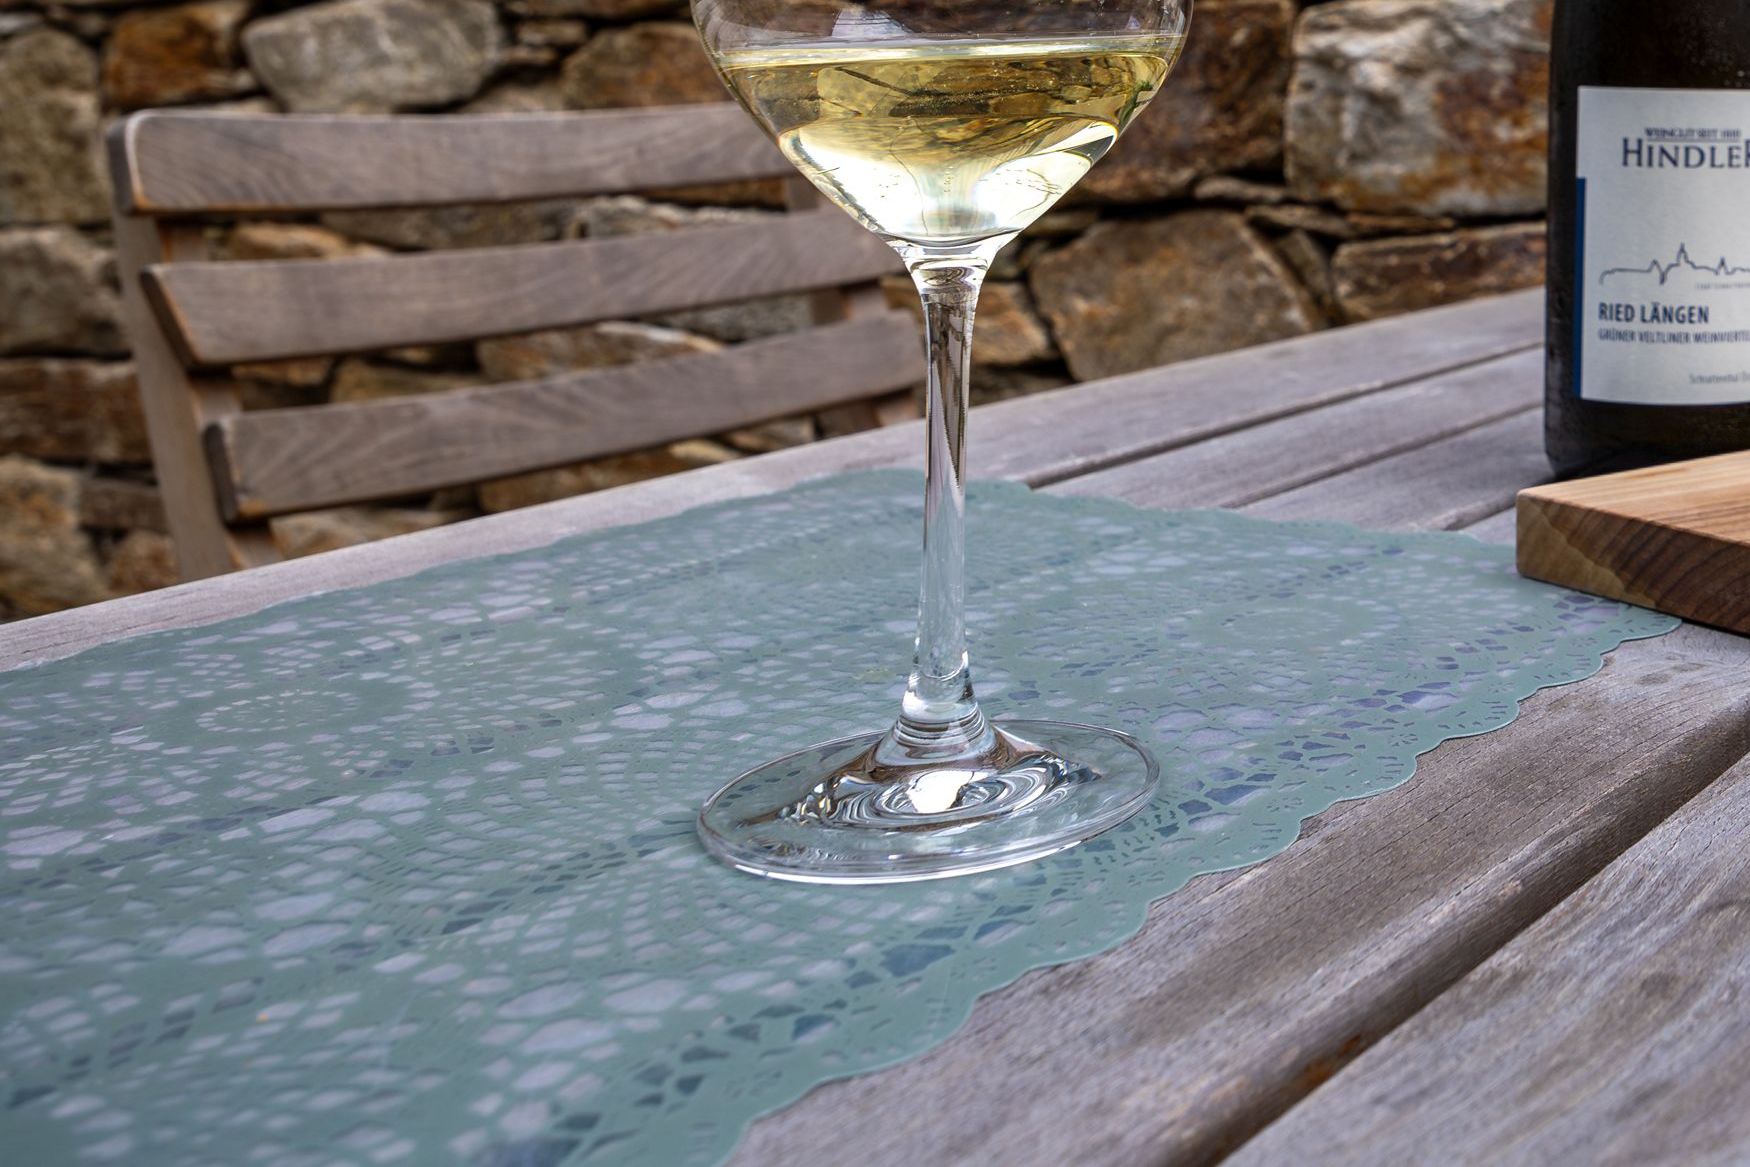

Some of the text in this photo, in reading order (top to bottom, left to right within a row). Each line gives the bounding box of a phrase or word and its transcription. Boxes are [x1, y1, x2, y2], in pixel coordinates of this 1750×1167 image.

[1598, 302, 1709, 324] RIED LÄNGEN
[1597, 327, 1636, 342] GRÜNER
[1638, 330, 1689, 344] VELTLINER
